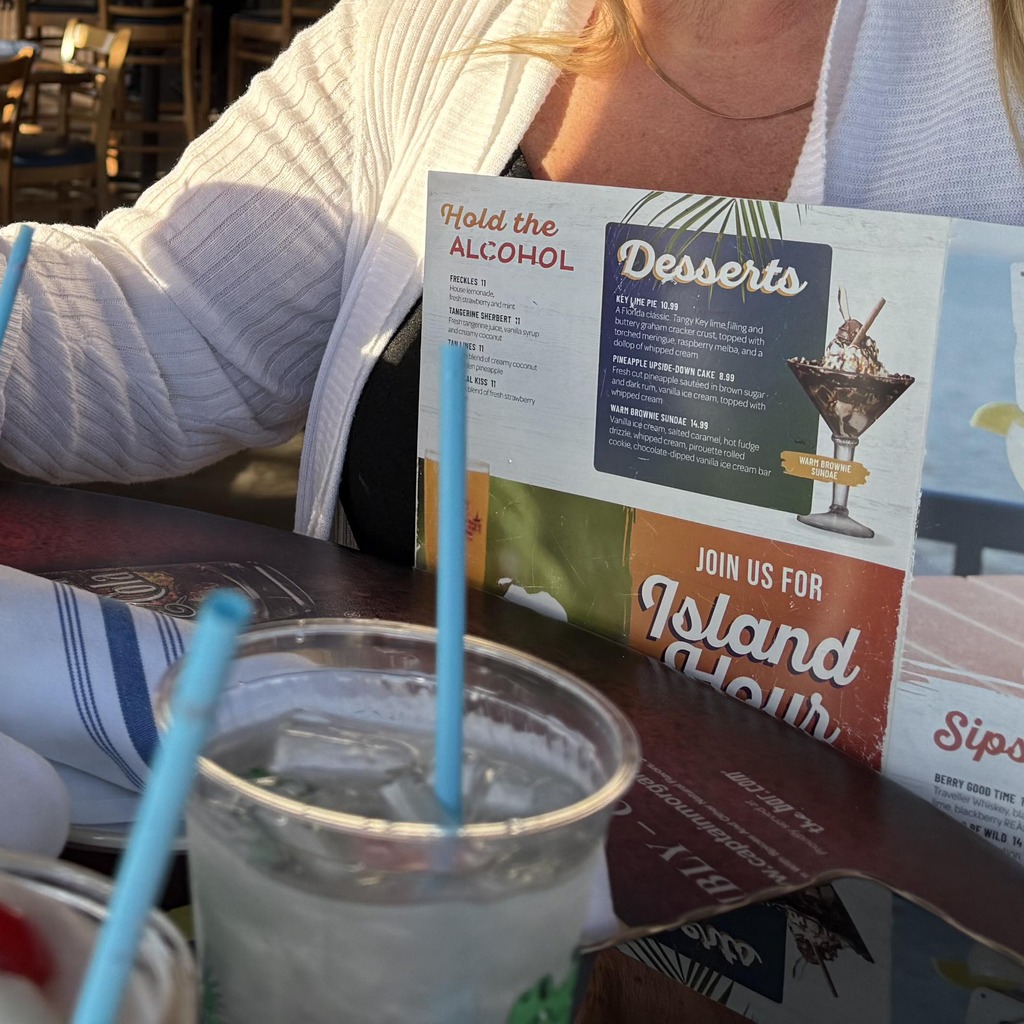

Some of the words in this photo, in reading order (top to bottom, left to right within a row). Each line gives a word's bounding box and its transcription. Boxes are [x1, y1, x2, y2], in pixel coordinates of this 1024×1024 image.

[441, 203, 507, 231] Hold
[513, 213, 559, 237] the
[450, 236, 574, 271] ALCOHOL
[617, 239, 808, 296] Desserts
[450, 275, 478, 286] FRECKLES
[450, 285, 465, 294] House
[450, 294, 462, 303] fresh
[463, 297, 490, 308] strawberry
[616, 296, 629, 304] KEY
[630, 297, 645, 307] LIME
[647, 300, 657, 308] PIE
[661, 301, 679, 311] 10.99
[449, 307, 479, 319] TANGERINE
[481, 312, 512, 323] SHERBERT
[616, 307, 621, 315] A
[622, 308, 645, 318] Florida
[673, 315, 694, 327] Tangy
[695, 318, 708, 329] Key
[727, 322, 747, 334] filling
[449, 317, 462, 326] Fresh
[462, 320, 488, 330] tangerine
[504, 327, 522, 335] vanilla
[523, 330, 540, 339] syrup
[459, 330, 478, 339] creamy
[479, 333, 503, 341] coconut
[615, 318, 640, 330] buttery
[641, 323, 668, 332] graham
[668, 327, 695, 336] cracker
[697, 331, 718, 340] crust,
[719, 333, 747, 344] topped
[749, 338, 765, 346] with
[614, 339, 635, 351] dollop
[636, 343, 643, 351] of
[644, 344, 674, 356] whipped
[675, 351, 698, 359] cream
[615, 330, 640, 340] torched
[678, 340, 714, 352] raspberry
[741, 349, 756, 357] and
[469, 353, 484, 362] blend
[491, 359, 512, 368] creamy
[513, 362, 538, 371] coconut
[476, 366, 504, 376] pineapple
[613, 355, 647, 368] PINEAPPLE
[649, 361, 695, 376] UPSIDE-DOWN
[697, 369, 715, 379] CAKE
[719, 372, 735, 382] 8.99
[475, 377, 488, 386] KISS
[613, 367, 630, 377] Fresh
[644, 373, 679, 385] pineapple
[711, 383, 718, 391] in
[719, 384, 743, 395] brown
[744, 390, 765, 399] sugar
[468, 386, 482, 395] blend
[490, 390, 504, 399] fresh
[504, 394, 536, 406] strawberry
[611, 389, 640, 401] whipped
[641, 396, 663, 405] cream
[612, 379, 625, 387] and
[626, 380, 640, 390] dark
[659, 388, 680, 397] vanilla
[682, 390, 692, 399] ice
[694, 394, 719, 404] cream,
[721, 397, 748, 408] topped
[750, 402, 766, 411] with
[611, 405, 629, 415] WARM
[631, 409, 659, 421] BROWNIE
[661, 414, 687, 426] SUNDAE
[691, 420, 709, 430] 14.99
[610, 416, 632, 427] Vanilla
[633, 421, 643, 429] ice
[668, 428, 690, 438] salted
[724, 438, 737, 447] hot
[738, 441, 760, 453] fudge
[634, 433, 662, 445] whipped
[689, 444, 722, 456] pirouette
[724, 451, 745, 461] rolled
[633, 444, 694, 462] chocolate-dipped
[696, 457, 718, 467] vanilla
[720, 461, 731, 469] ice
[732, 465, 756, 474] cream
[758, 468, 771, 477] bar
[799, 456, 819, 469] WARM
[821, 458, 851, 474] BROWNIE
[811, 467, 837, 480] SUNDAE
[696, 547, 740, 581] JOIN
[747, 558, 774, 590] US
[781, 566, 823, 602] FOR
[639, 574, 861, 687] Island
[933, 710, 1024, 763] Sips
[934, 773, 965, 790] BERRY
[966, 782, 991, 797] GOOD
[994, 789, 1017, 804] TIME
[934, 786, 970, 803] Traveller
[954, 805, 1003, 825] blackberry
[984, 828, 1007, 843] WILD
[1013, 836, 1023, 848] 14
